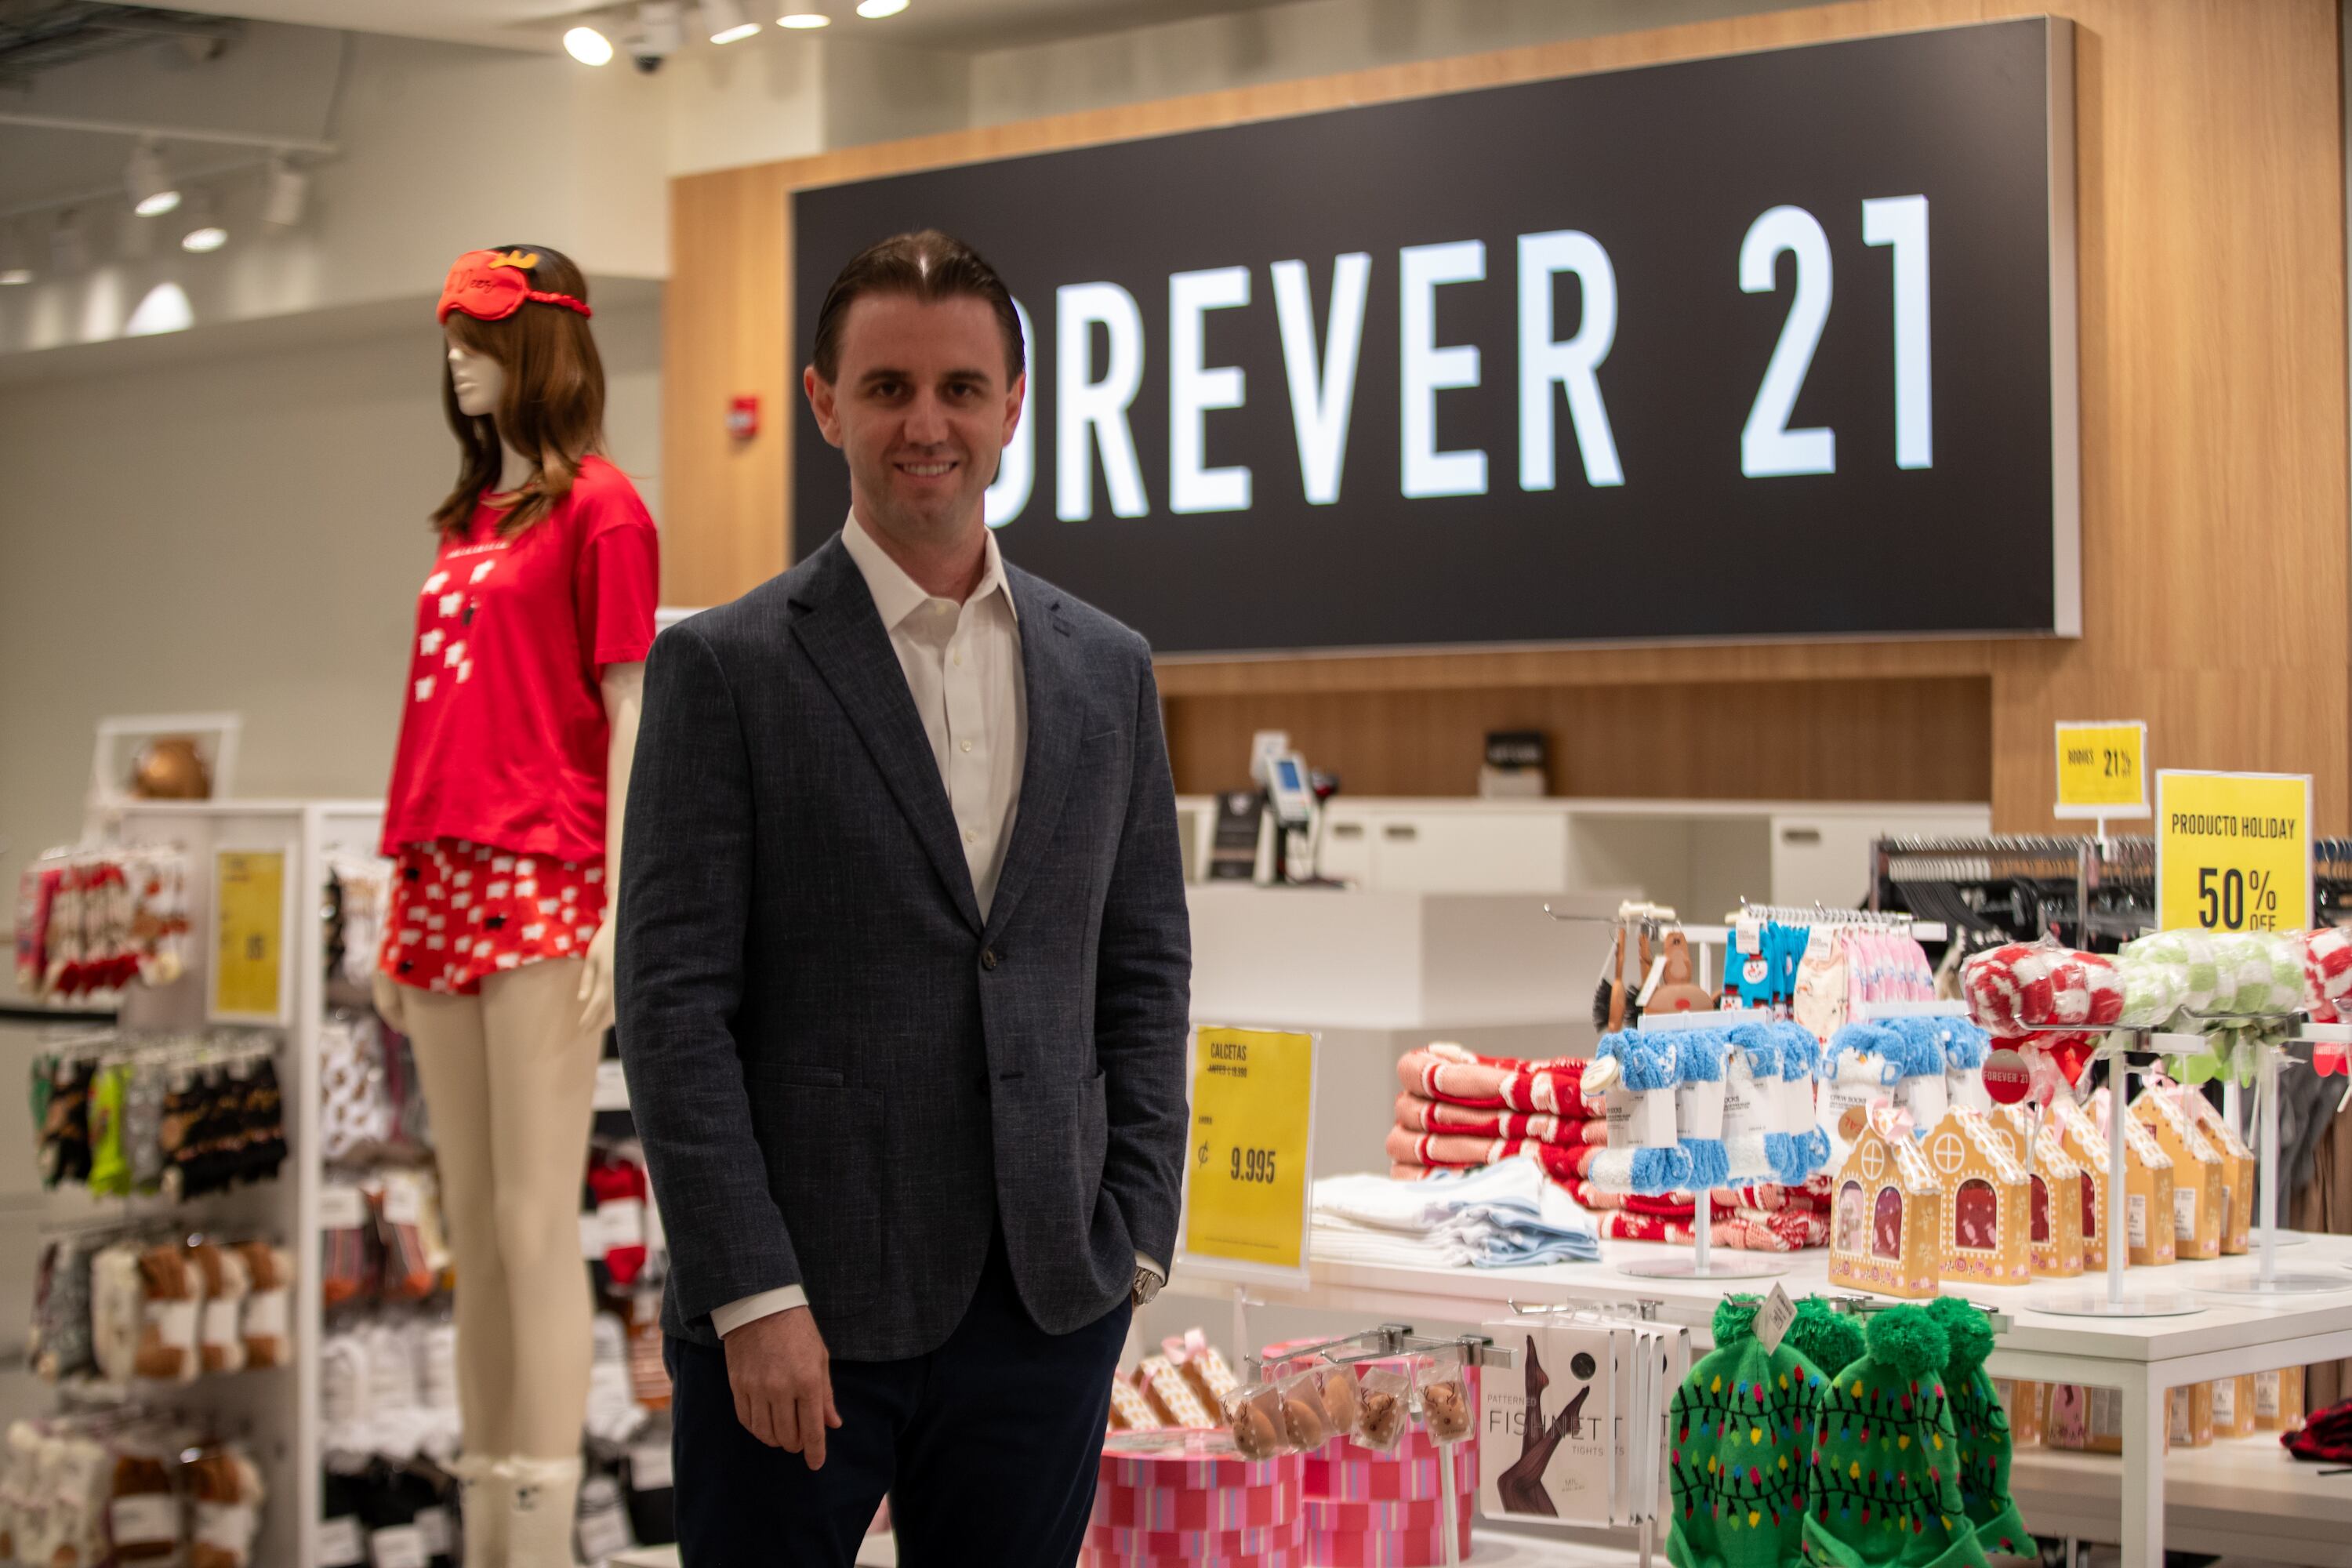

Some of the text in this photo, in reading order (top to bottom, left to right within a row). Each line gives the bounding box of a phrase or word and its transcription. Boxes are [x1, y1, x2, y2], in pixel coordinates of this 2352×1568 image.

[984, 194, 1934, 528] REVER 21
[2171, 813, 2296, 840] PRODUCTO HOLIDAY
[2198, 867, 2277, 931] 50%
[1210, 1043, 1247, 1061] CALCETAS
[1983, 1071, 2029, 1084] FOREVER 21
[1230, 1147, 1276, 1184] 9.995
[1487, 1395, 1537, 1406] PATTERNED
[1490, 1410, 1602, 1441] FISHNET
[1573, 1446, 1604, 1457] TIGHTS
